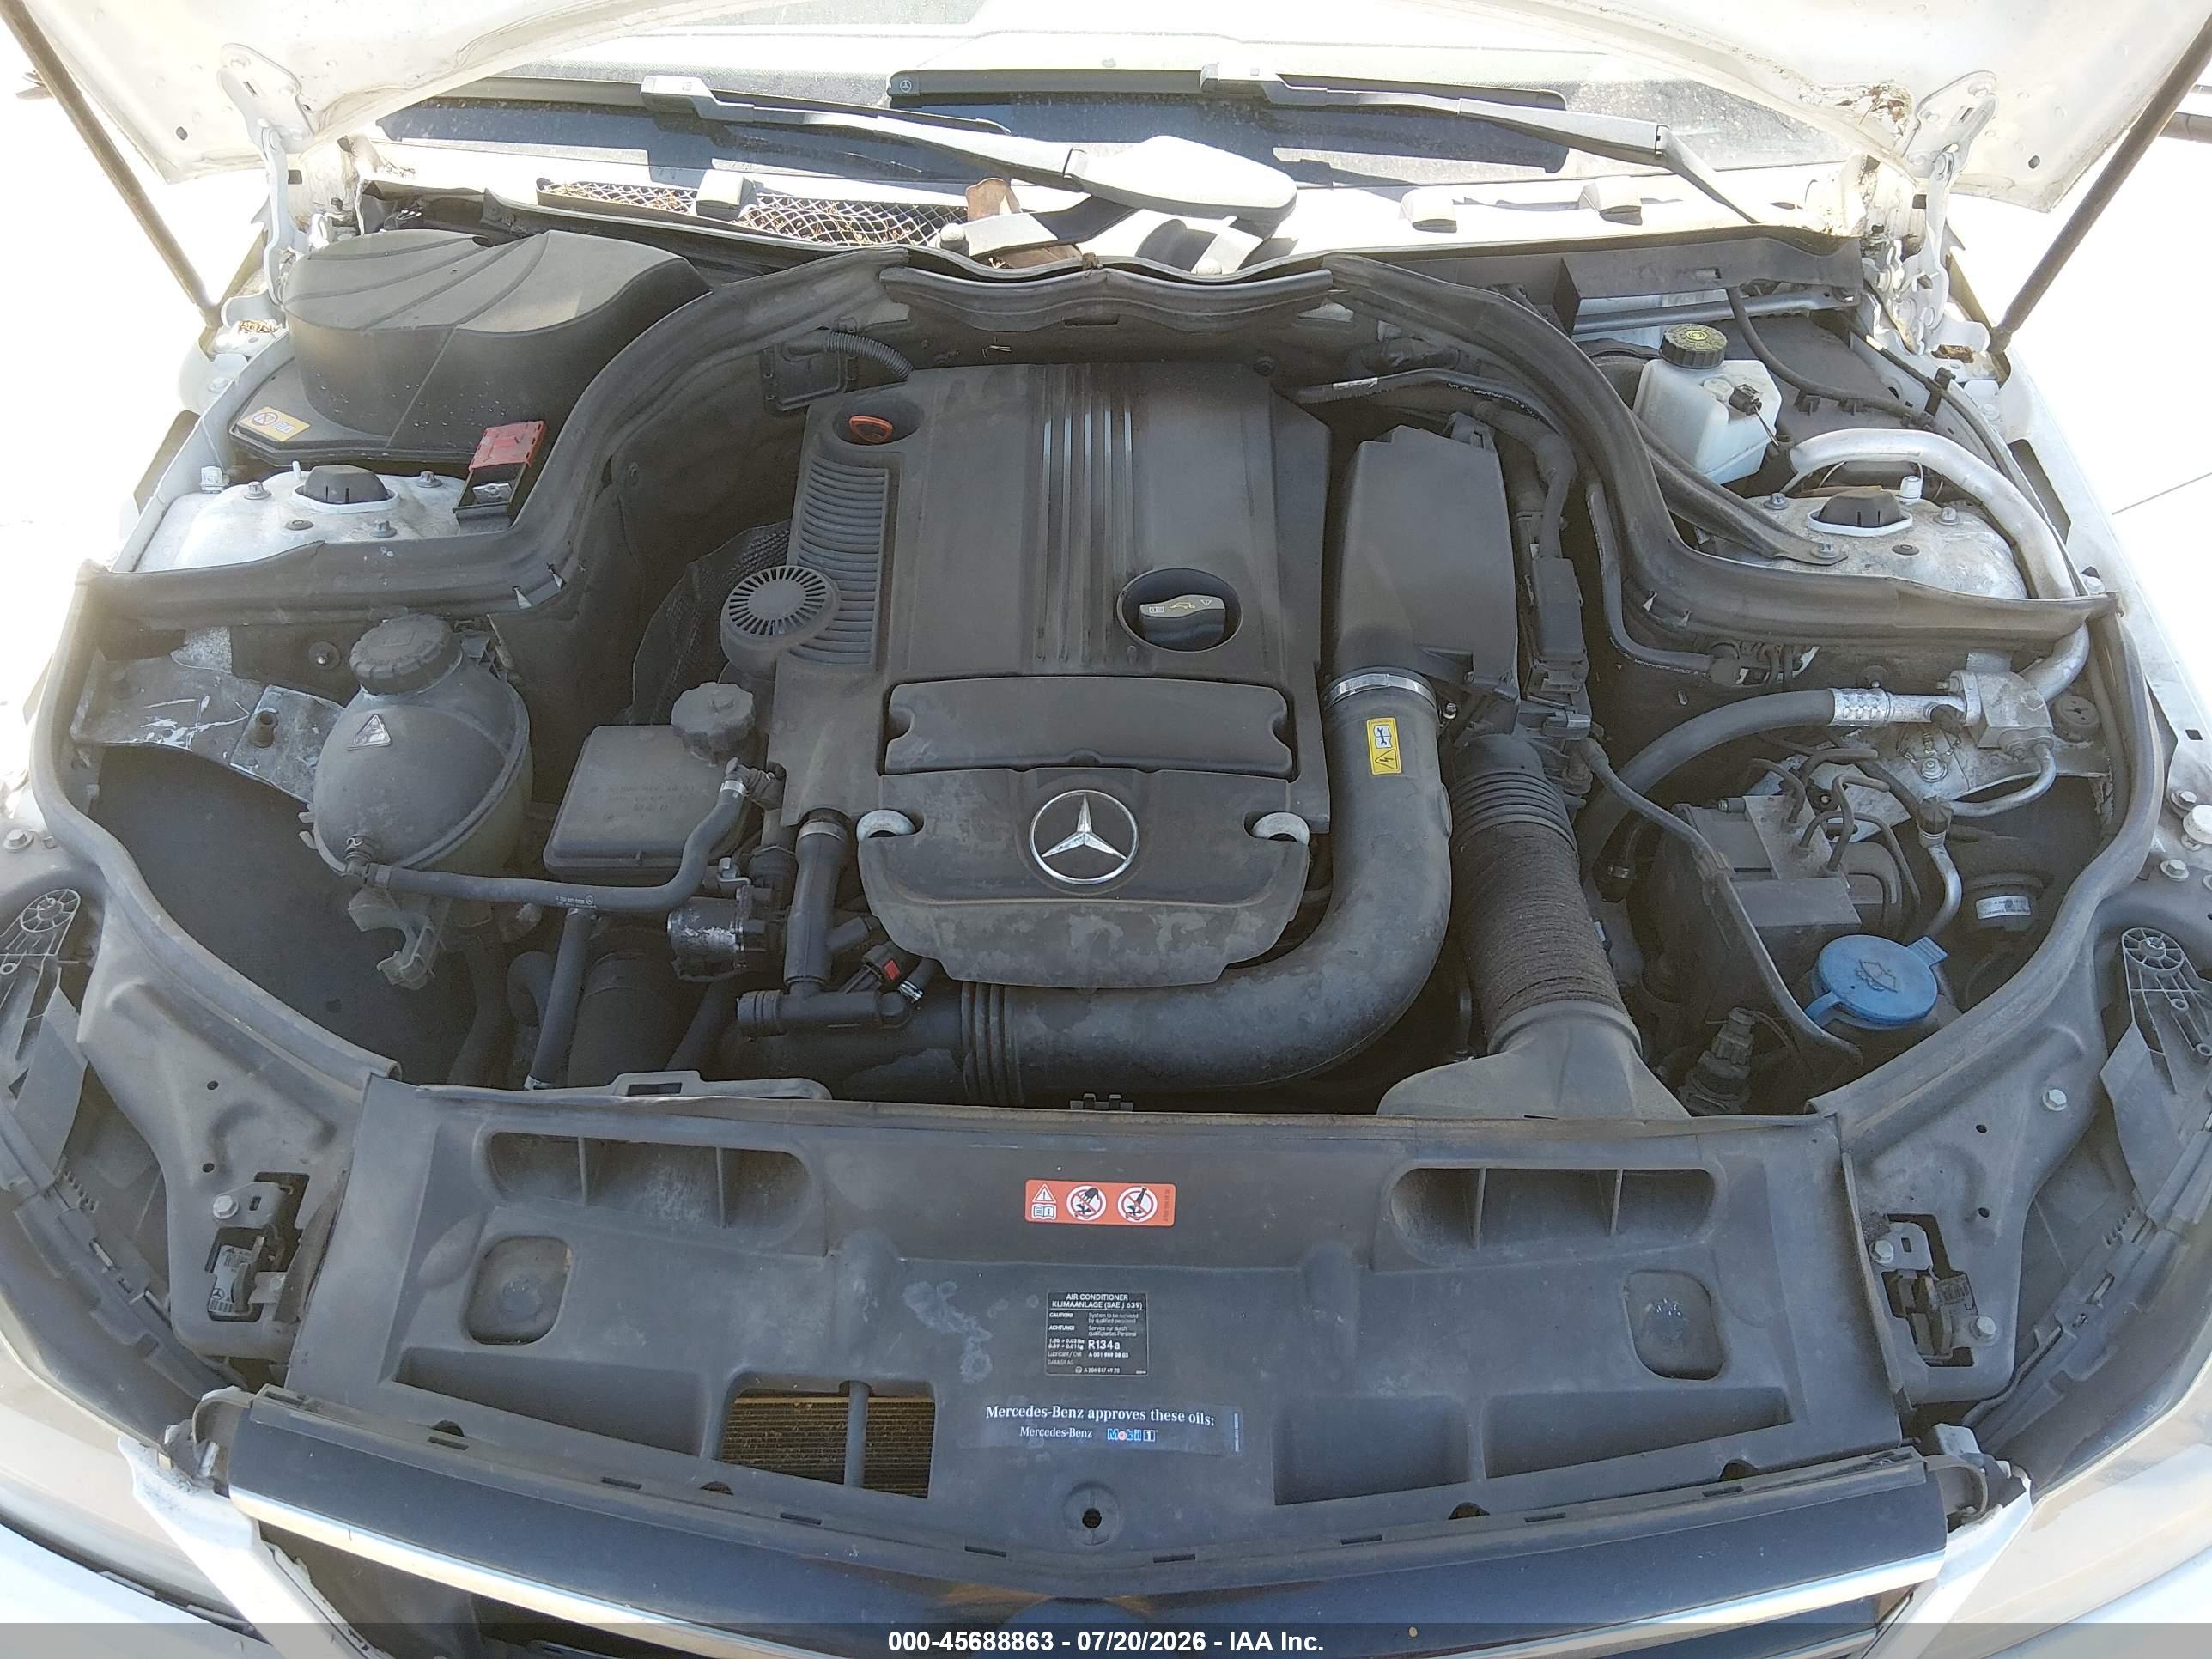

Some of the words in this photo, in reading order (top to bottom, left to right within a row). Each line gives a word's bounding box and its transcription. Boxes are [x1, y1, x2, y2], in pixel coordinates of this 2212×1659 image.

[1088, 1340, 1121, 1350] R134a
[986, 1405, 1084, 1419] Mercedes-Benz
[1087, 1408, 1146, 1422] approves
[1151, 1408, 1185, 1422] these
[1188, 1412, 1215, 1426] oils:
[1020, 1426, 1093, 1438] Mercedes-Benz
[1107, 1428, 1142, 1441] Mobil
